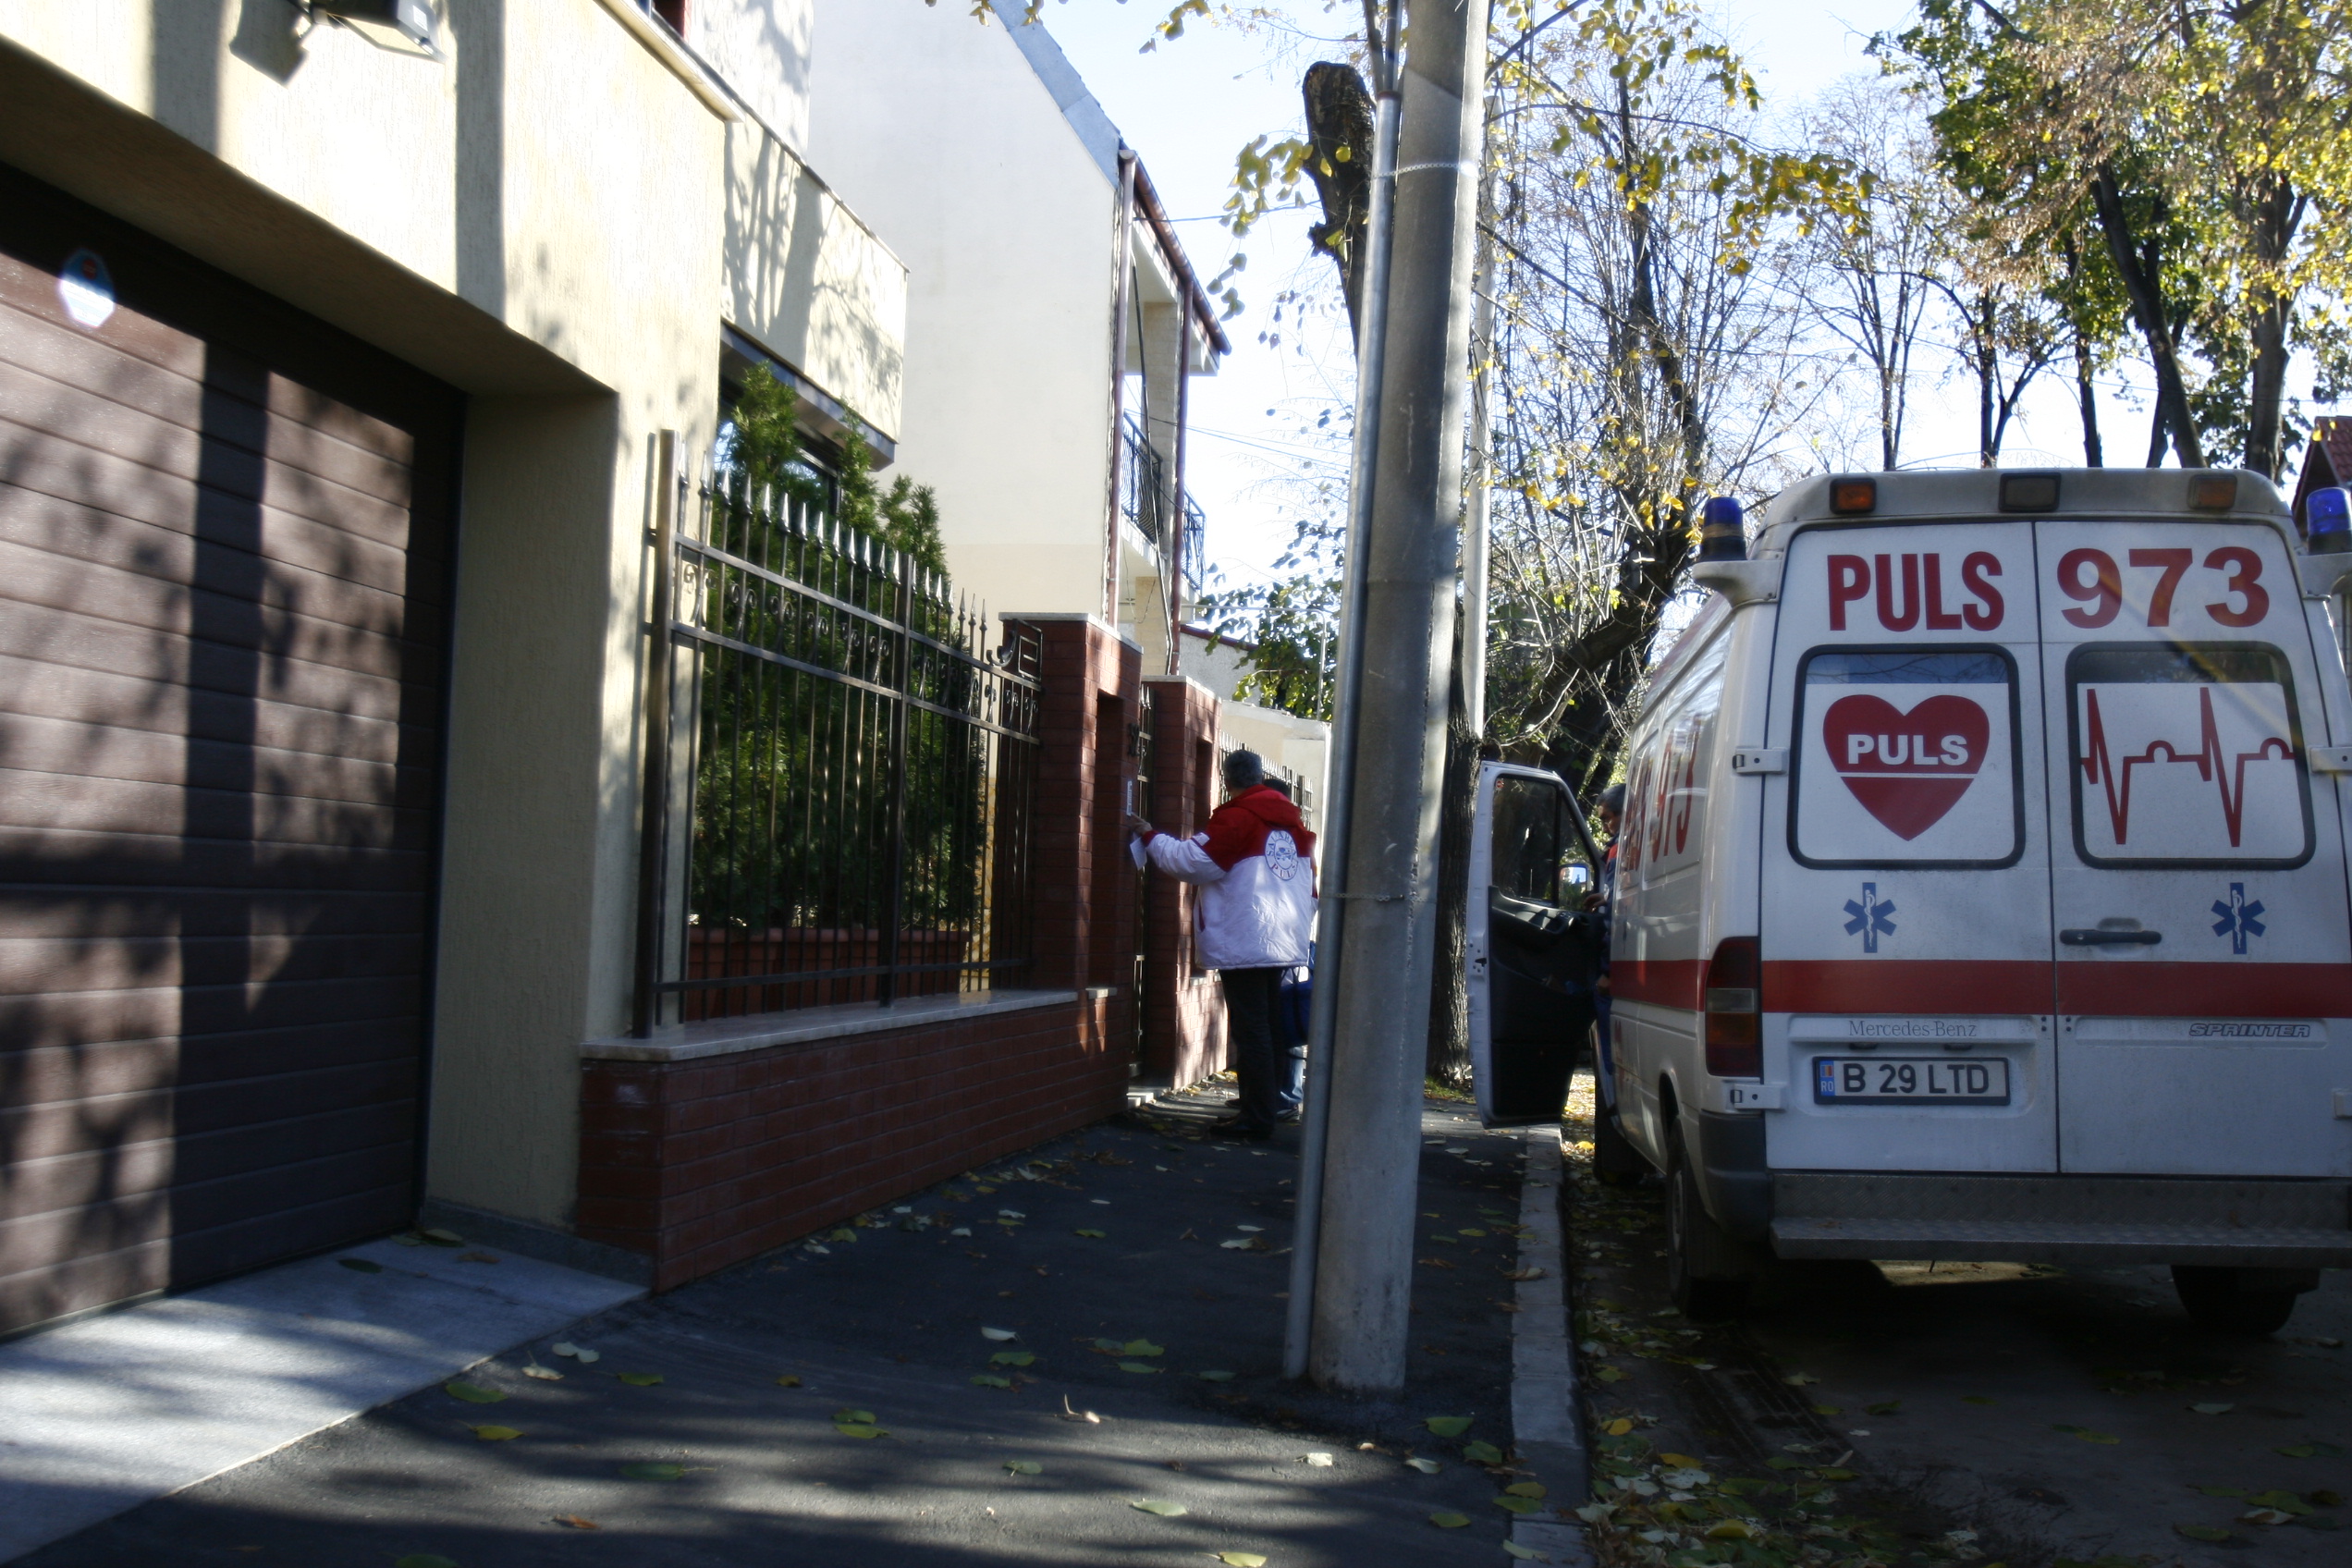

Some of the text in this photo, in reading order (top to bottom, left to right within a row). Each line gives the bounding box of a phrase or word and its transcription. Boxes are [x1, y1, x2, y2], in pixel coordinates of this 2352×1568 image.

[1827, 545, 2270, 632] PULS 973
[1847, 733, 1969, 766] PULS
[1848, 1020, 1978, 1037] Mercedes-Benz
[2188, 1023, 2310, 1037] SPRINTER
[1819, 1081, 1834, 1092] RO
[1843, 1063, 1990, 1094] B 29 LTD
